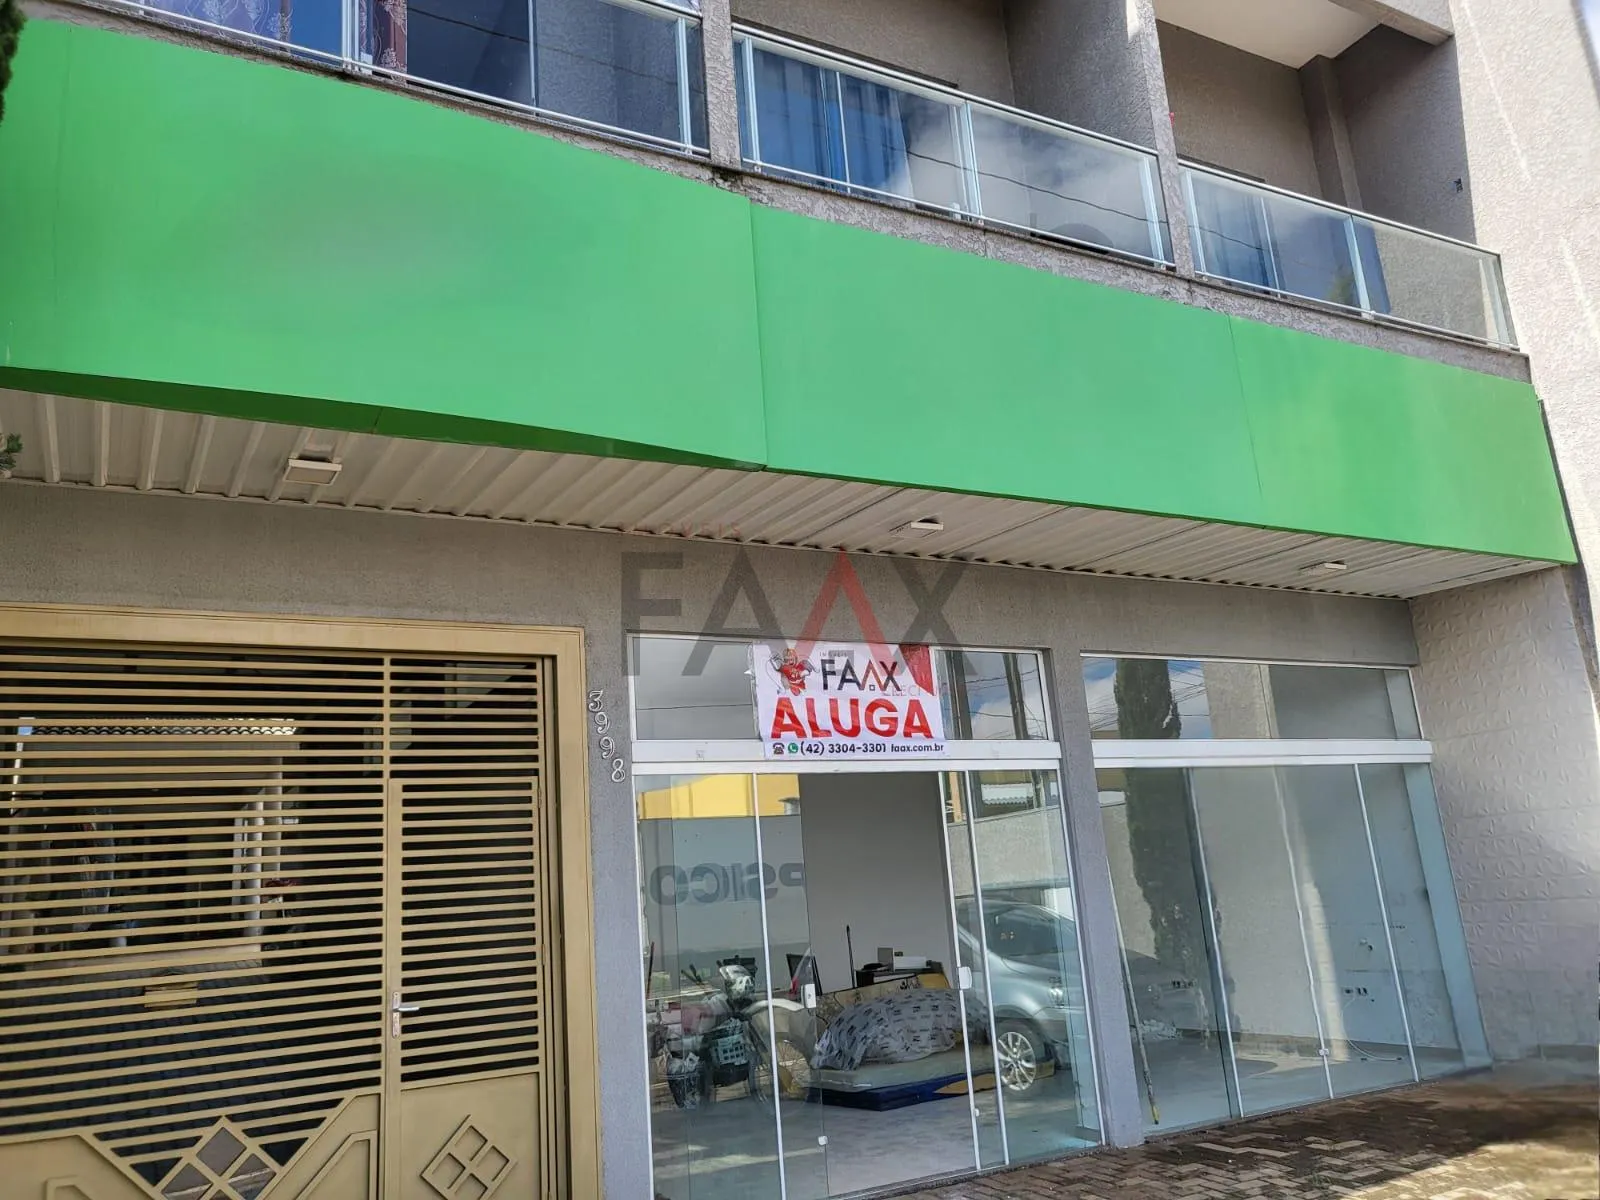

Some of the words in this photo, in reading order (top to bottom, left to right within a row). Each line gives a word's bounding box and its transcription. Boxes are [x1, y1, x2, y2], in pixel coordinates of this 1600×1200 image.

[588, 690, 625, 782] 3998
[771, 697, 934, 739] ALUGA
[801, 741, 825, 756] (42)
[828, 743, 886, 754] 3304-3301
[891, 743, 945, 753] faax.com.br
